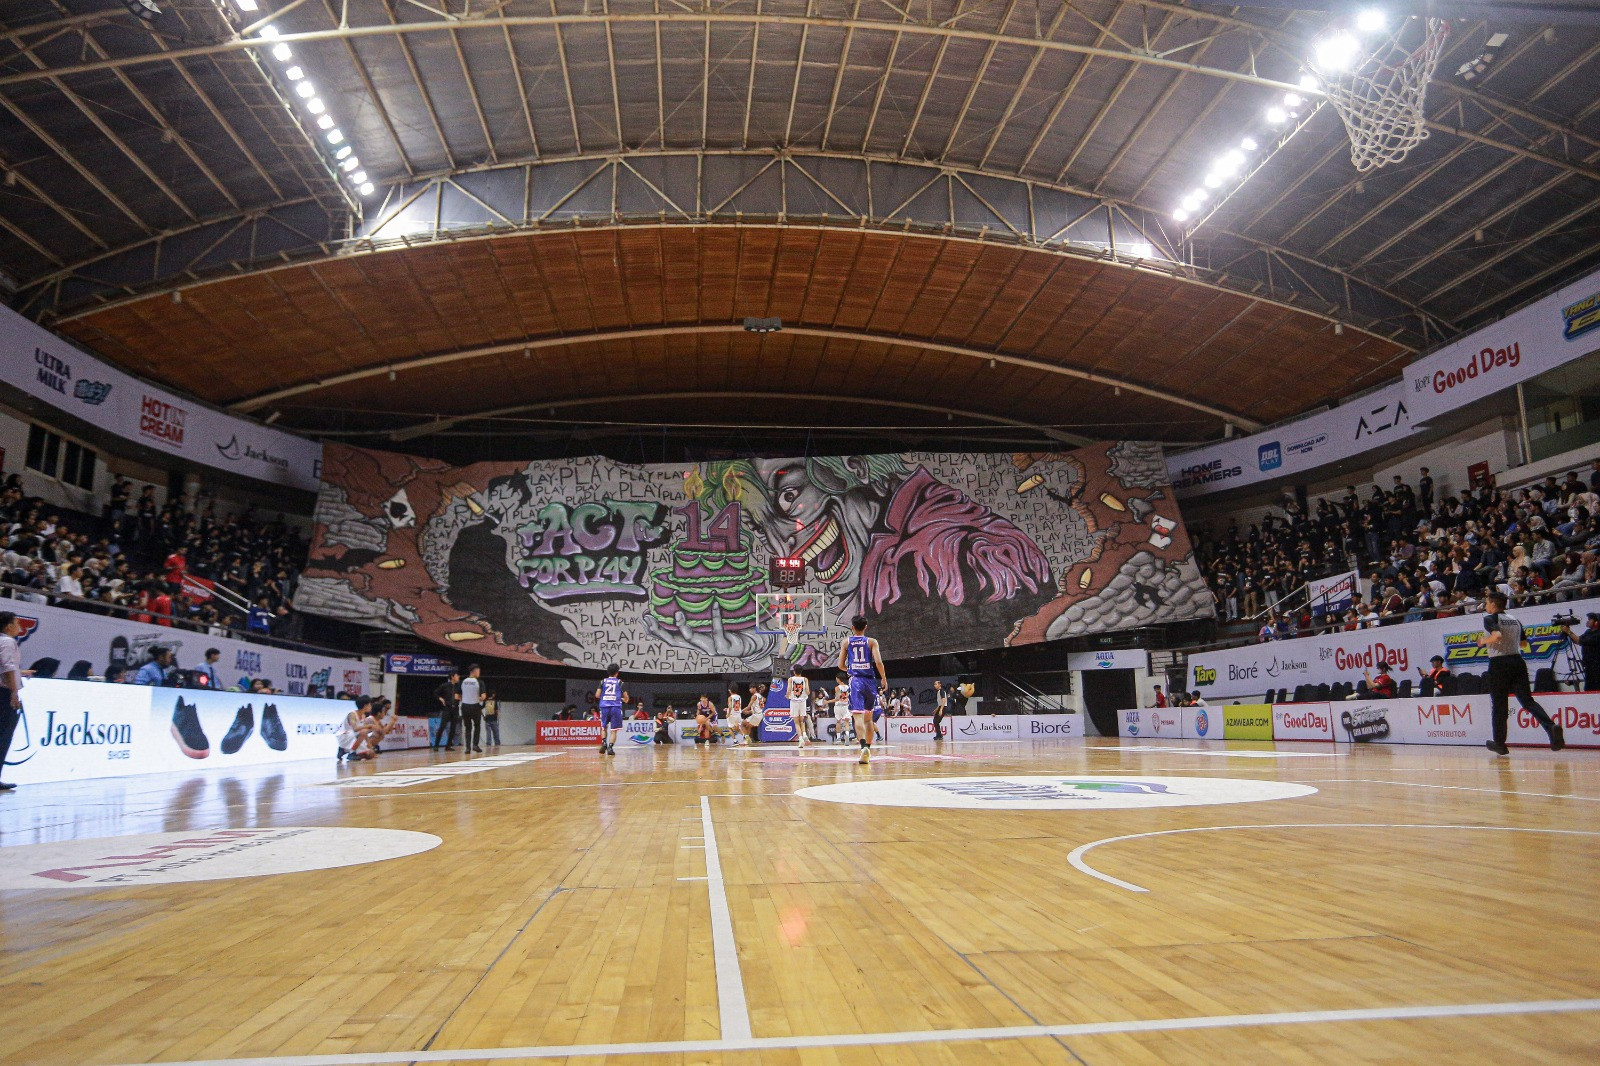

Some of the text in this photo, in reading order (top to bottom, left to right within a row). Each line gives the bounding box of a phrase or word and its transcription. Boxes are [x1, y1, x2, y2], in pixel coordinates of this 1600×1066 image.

[35, 347, 71, 380] ULTRA
[1433, 354, 1479, 394] Good
[1480, 341, 1522, 374] Day
[36, 367, 66, 395] MILK
[140, 413, 185, 444] CREAM
[1286, 435, 1326, 453] DOWNLOAD APP
[1300, 446, 1313, 454] NOW
[243, 445, 289, 467] Jackson
[938, 453, 979, 467] PLAY
[1261, 450, 1279, 461] DBL
[1261, 458, 1280, 466] PLAY
[559, 465, 615, 485] PLAY
[933, 467, 964, 478] PLAY
[1181, 459, 1222, 478] HOME
[620, 469, 654, 483] PLAY
[966, 469, 1005, 489] PLAY
[1172, 466, 1242, 490] REAMERS
[535, 486, 567, 496] PLAY
[576, 483, 601, 494] PLAY
[619, 481, 663, 500] PLAY
[974, 487, 999, 498] PLAY
[997, 500, 1028, 511] PLAY
[1010, 514, 1033, 523] PLAY
[517, 500, 663, 557] ACT
[672, 500, 742, 552] 14
[1026, 520, 1055, 533] PLAY
[1035, 532, 1060, 543] PLAY
[1044, 542, 1072, 555] PLAY
[1049, 555, 1074, 565] PLAY
[573, 555, 642, 586] PLAY
[580, 613, 618, 627] PLAY
[594, 629, 636, 643] PLAY
[600, 643, 622, 652] PLAY
[627, 643, 663, 657] PLAY
[583, 652, 617, 664] PLAY
[666, 650, 700, 661] PLAY
[852, 646, 866, 663] 11
[1095, 651, 1115, 661] AQUA
[1335, 645, 1374, 671] Good
[1374, 642, 1409, 672] Day
[619, 658, 660, 670] PLAY
[660, 661, 699, 673] PLAY
[700, 657, 736, 668] PLAY
[1281, 659, 1307, 670] Jackson
[1194, 665, 1216, 683] Taro
[1228, 661, 1258, 681] Bioré
[604, 683, 617, 695] 21
[626, 722, 655, 734] AQUA
[900, 723, 947, 735] Good Dy
[980, 722, 1012, 731] Jackson
[1030, 720, 1071, 734] Bioré
[1283, 712, 1328, 733] Good Day
[40, 711, 132, 748] Jackson
[569, 726, 601, 736] CREAM
[1427, 730, 1467, 738] DISTRIBUTOR
[107, 749, 131, 761] SHOES
